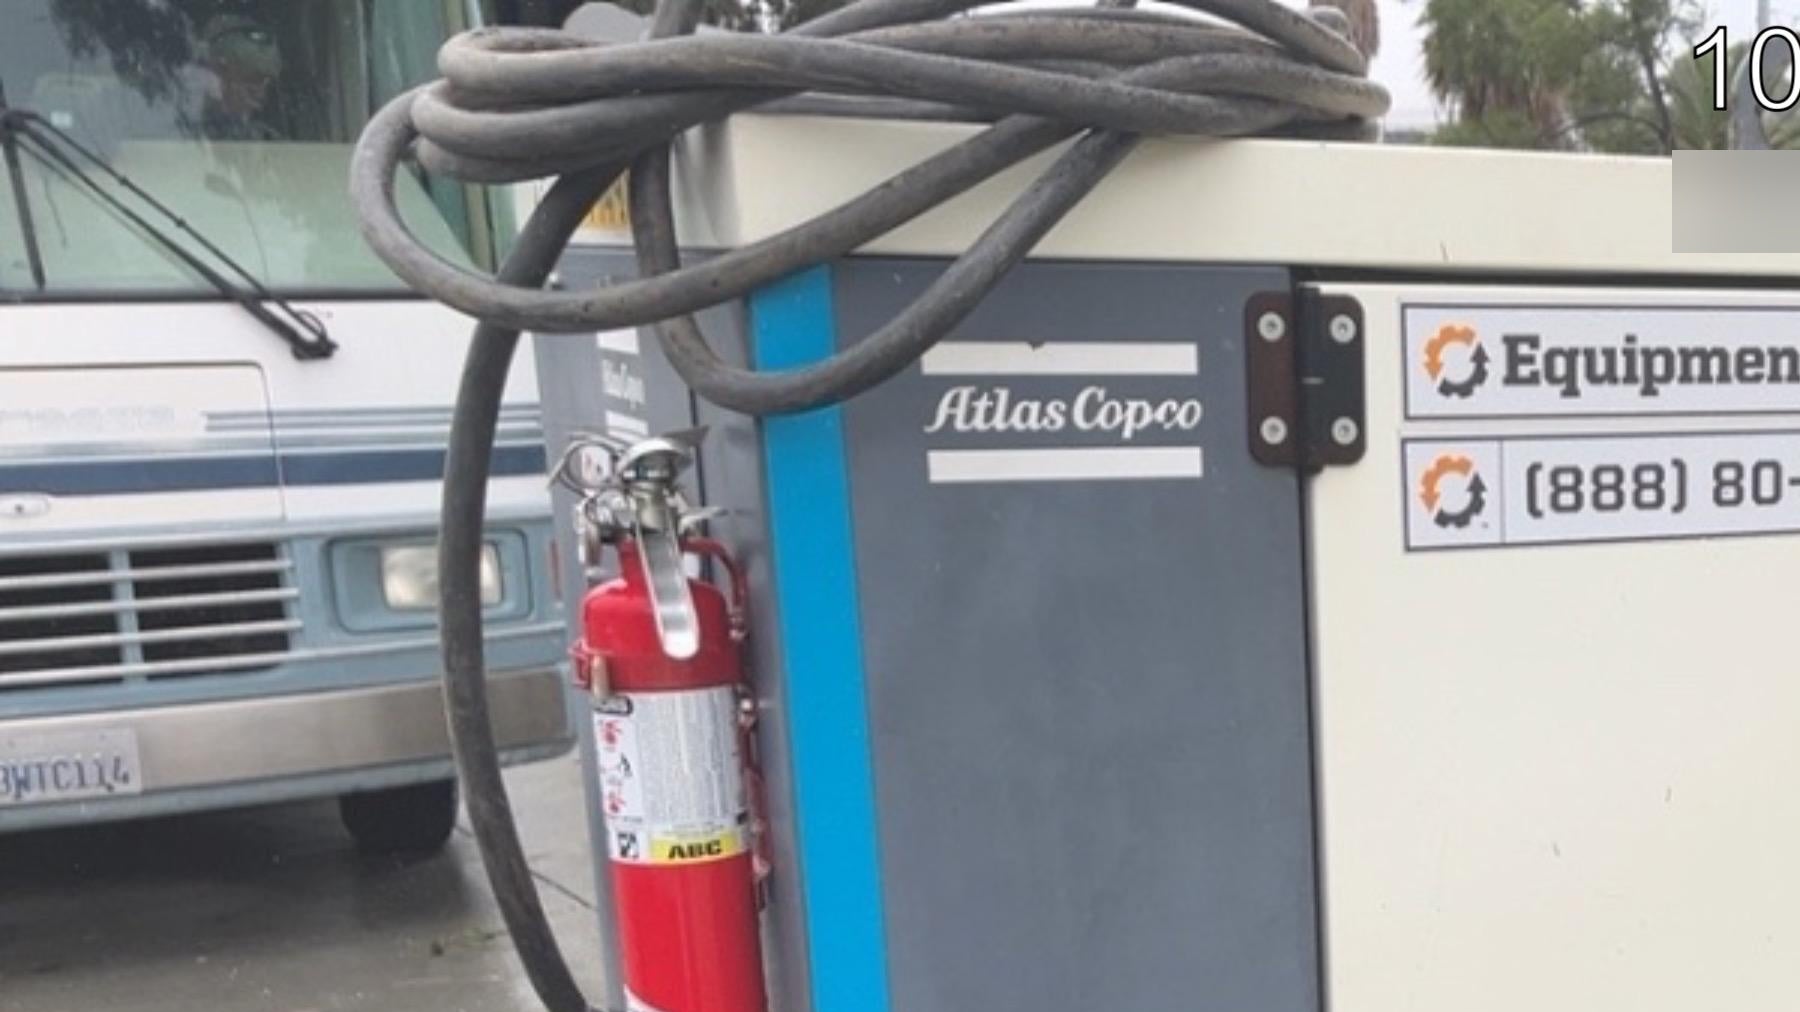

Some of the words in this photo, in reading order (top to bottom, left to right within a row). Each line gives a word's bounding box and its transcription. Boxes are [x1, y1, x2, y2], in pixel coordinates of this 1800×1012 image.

[924, 385, 1066, 433] Atlas
[1072, 385, 1201, 440] Copco
[1525, 458, 1689, 518] (888)
[668, 839, 722, 859] ABC
